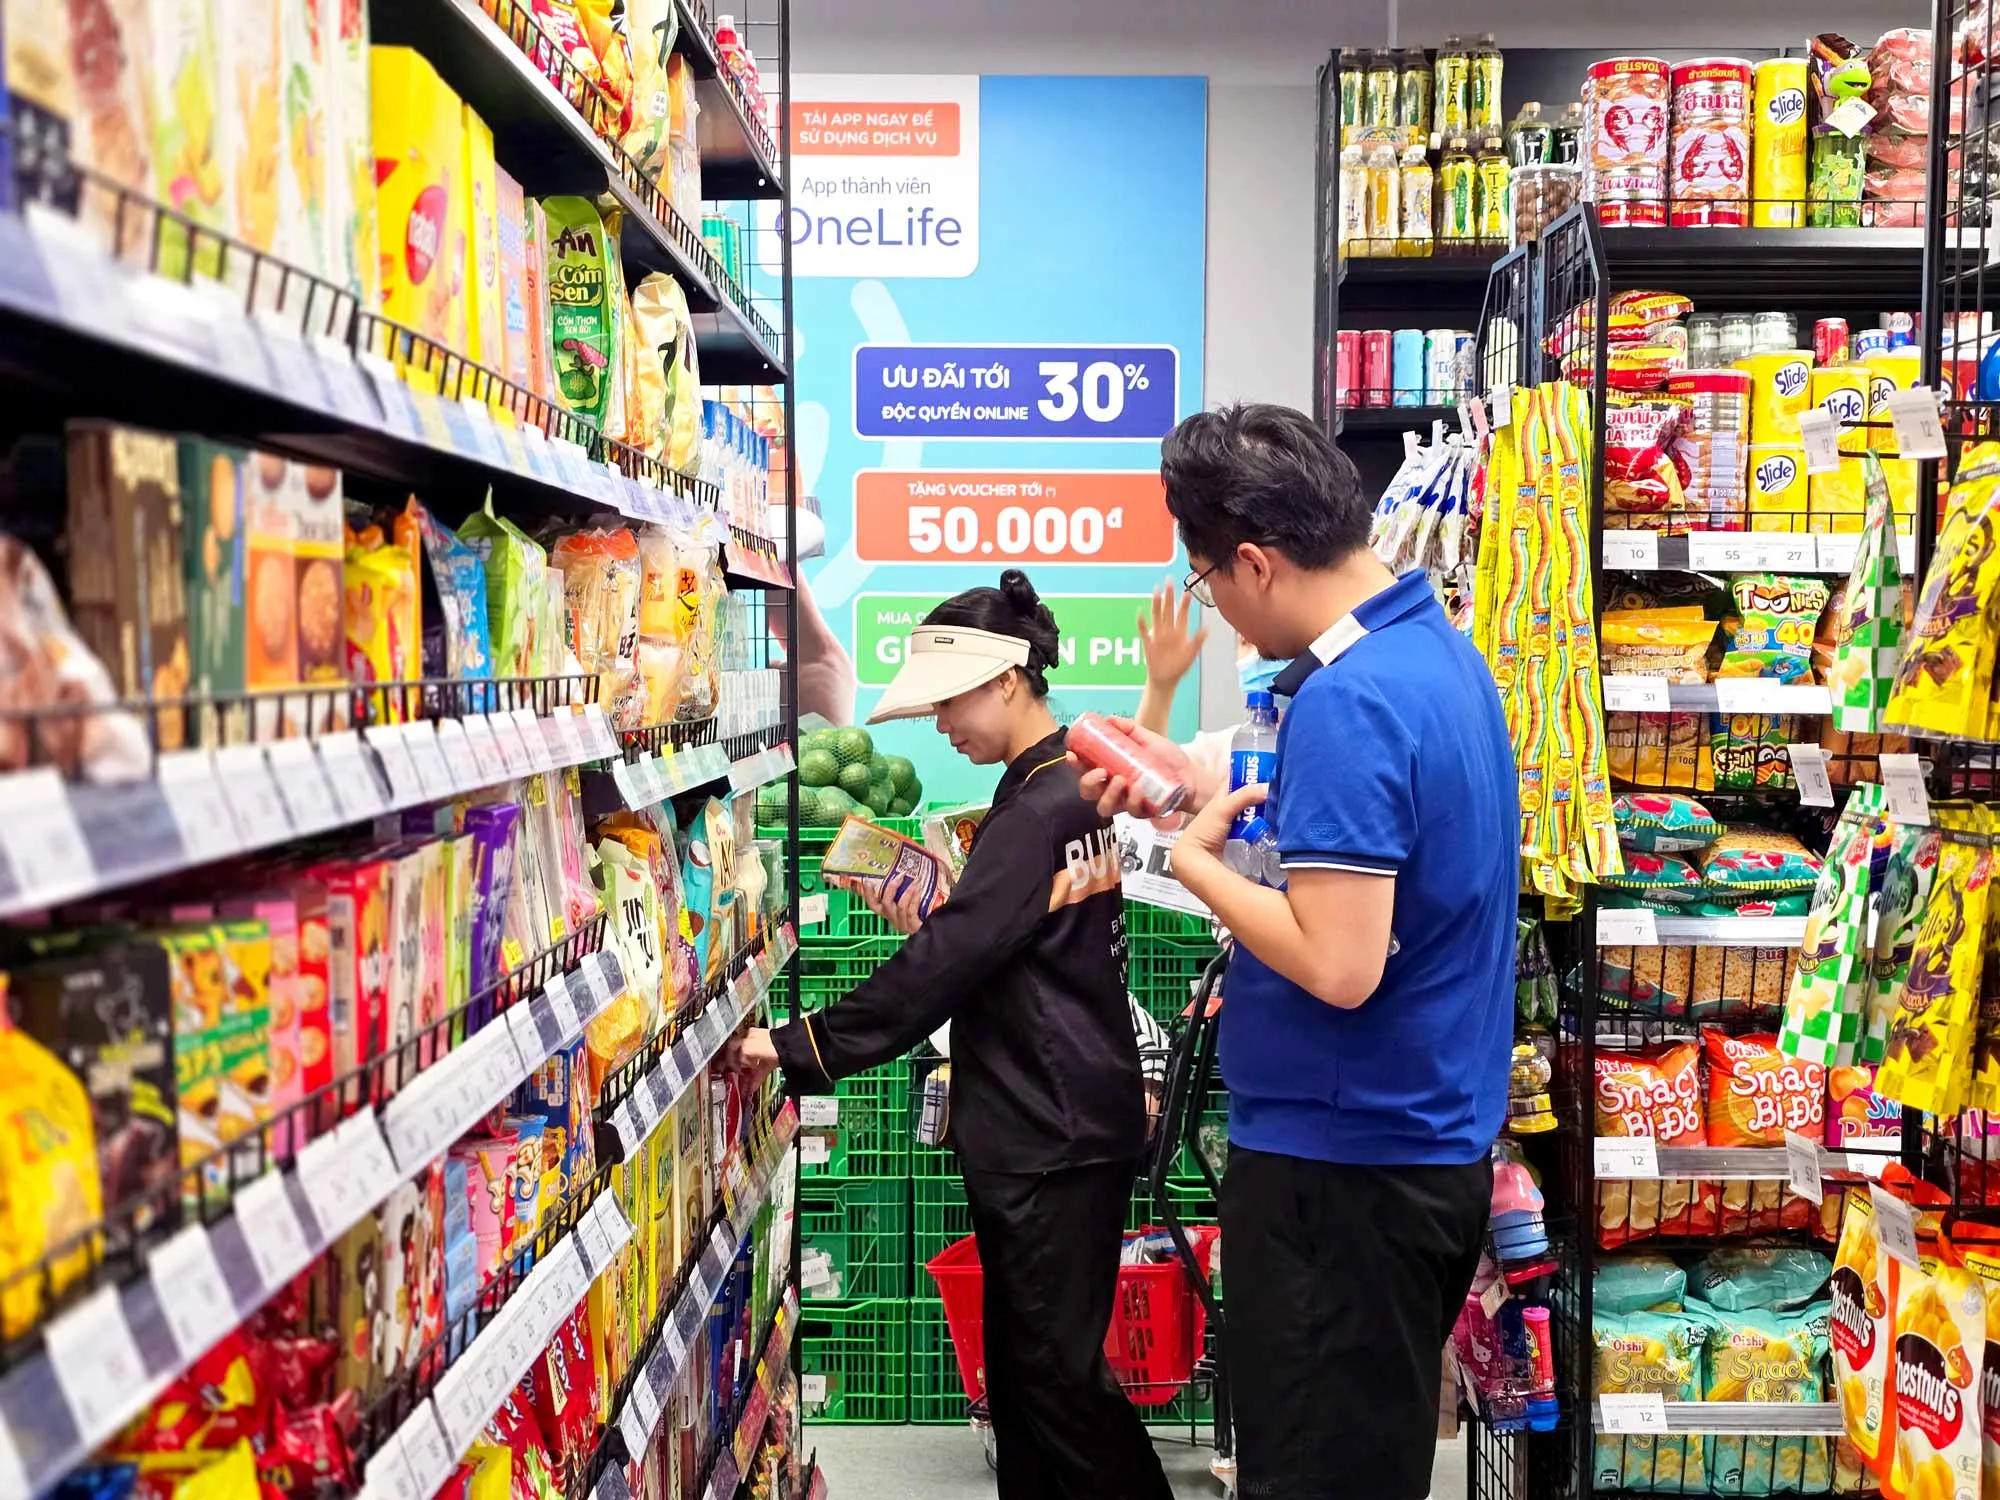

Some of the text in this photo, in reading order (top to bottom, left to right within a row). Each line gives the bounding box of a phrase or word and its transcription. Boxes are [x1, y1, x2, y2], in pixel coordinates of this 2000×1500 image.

[1769, 93, 1803, 122] Slide
[803, 110, 826, 126] TẢI
[830, 112, 863, 126] APP
[866, 112, 908, 126] NGAY
[824, 132, 869, 147] DỤNG
[871, 132, 911, 147] DỊCH
[914, 132, 937, 147] VỤ
[801, 175, 931, 197] App thành viên
[775, 206, 963, 248] OneLife
[549, 281, 590, 303] Sen
[882, 362, 1011, 390] ƯU ĐÃI TỚI
[1775, 363, 1808, 396] Slide
[882, 404, 916, 424] ĐỘC
[974, 406, 1029, 421] ONLINE
[1819, 395, 1862, 418] lide
[1756, 459, 1792, 492] Slide
[908, 480, 946, 499] TẶNG
[949, 483, 1014, 498] VOUCHER
[1017, 480, 1043, 497] TỚI
[1630, 549, 1645, 560] 10
[1725, 550, 1740, 560] 55
[1787, 551, 1802, 561] 27
[877, 611, 913, 625] MUA
[1776, 620, 1815, 647] 40
[1725, 1042, 1767, 1057] Oishi
[1631, 1155, 1645, 1166] 12
[1613, 1338, 1644, 1353] Oishi
[1731, 1333, 1764, 1348] Oishi
[1607, 1357, 1692, 1386] Snack
[1728, 1351, 1813, 1382] Snack
[1639, 1411, 1653, 1422] 12
